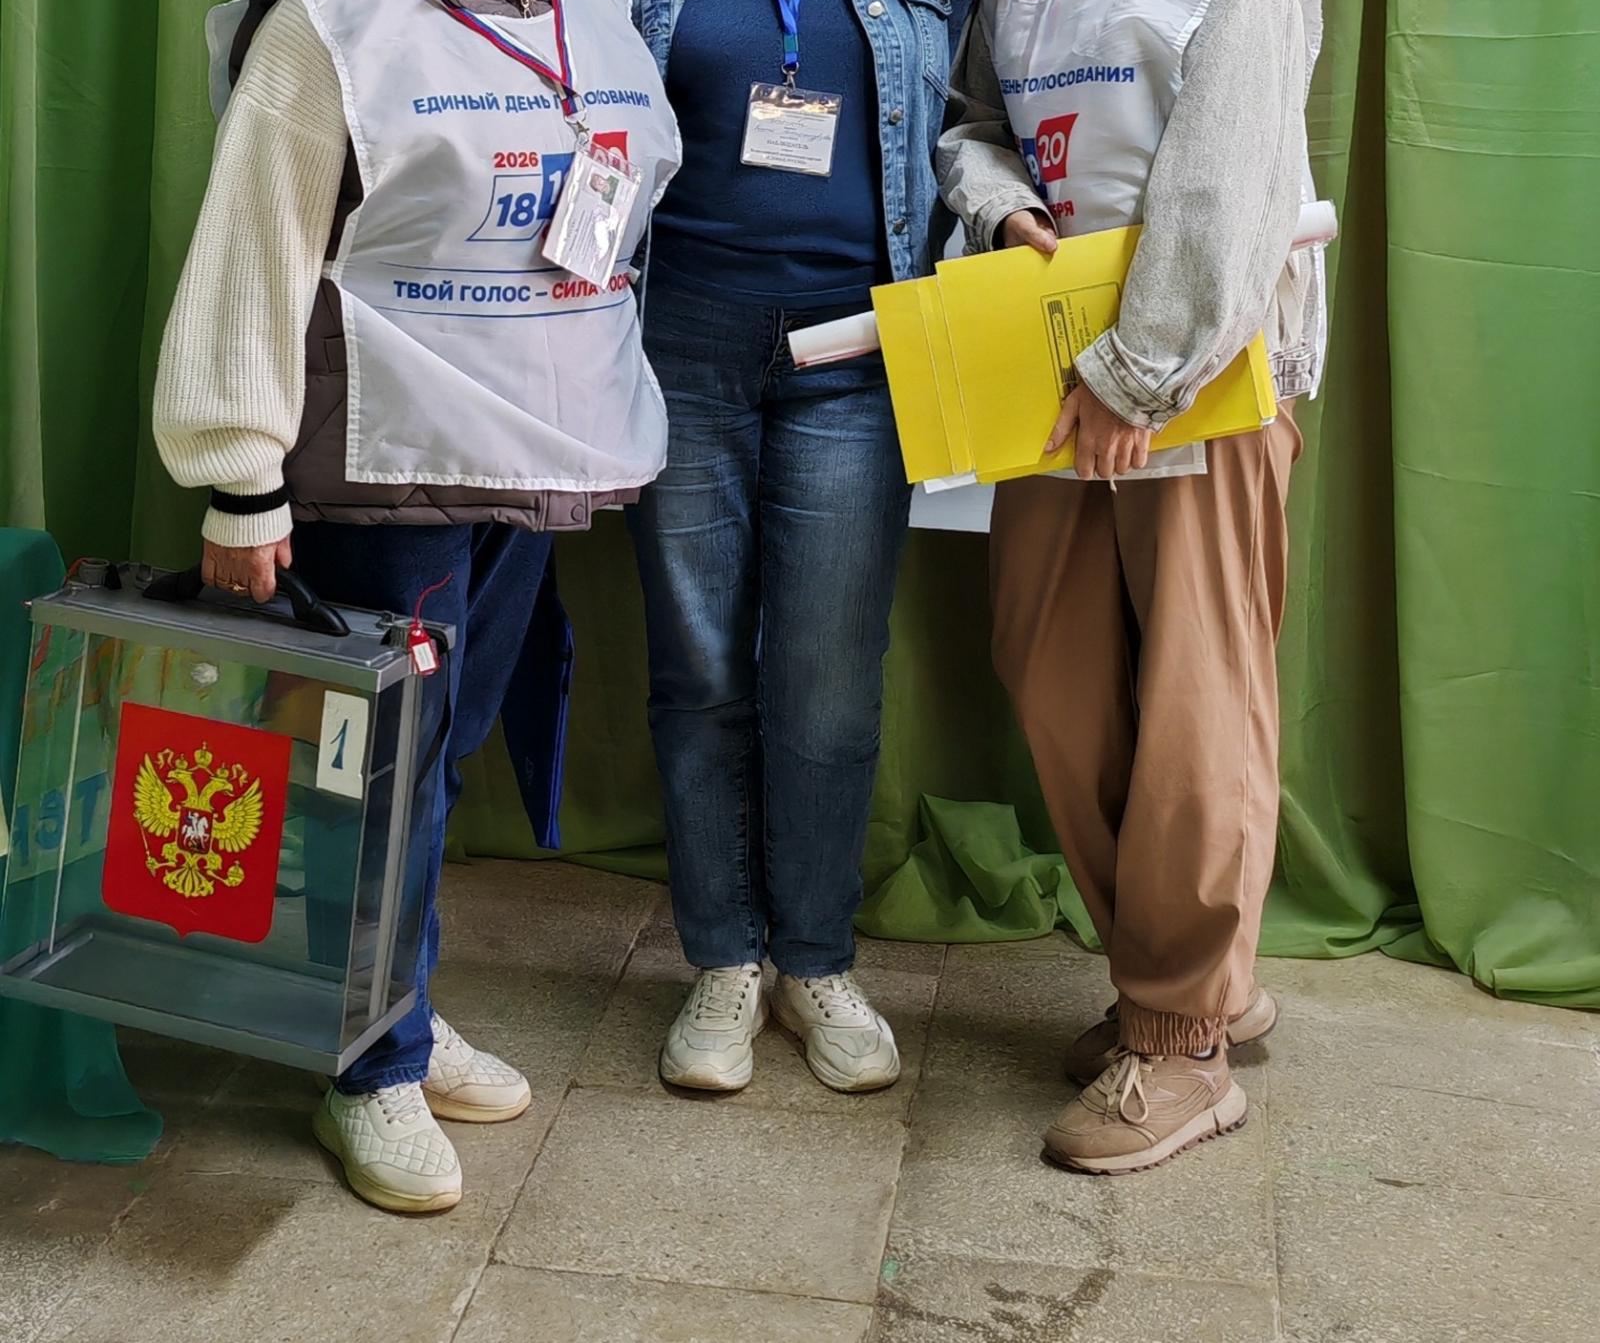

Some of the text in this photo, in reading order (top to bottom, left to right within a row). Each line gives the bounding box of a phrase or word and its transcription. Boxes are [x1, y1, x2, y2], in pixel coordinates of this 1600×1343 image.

[1022, 65, 1135, 93] ГОЛОСОВАНИЯ
[413, 92, 500, 115] ЕДИНЫЙ
[504, 94, 551, 113] ДЕНЬ
[493, 151, 539, 169] 2026
[1037, 131, 1066, 168] 20
[496, 192, 537, 228] 18
[549, 170, 568, 205] 1
[393, 280, 453, 302] ТВОЙ
[460, 284, 531, 302] ГОЛОС
[552, 280, 599, 300] СИЛА
[330, 719, 351, 770] 1
